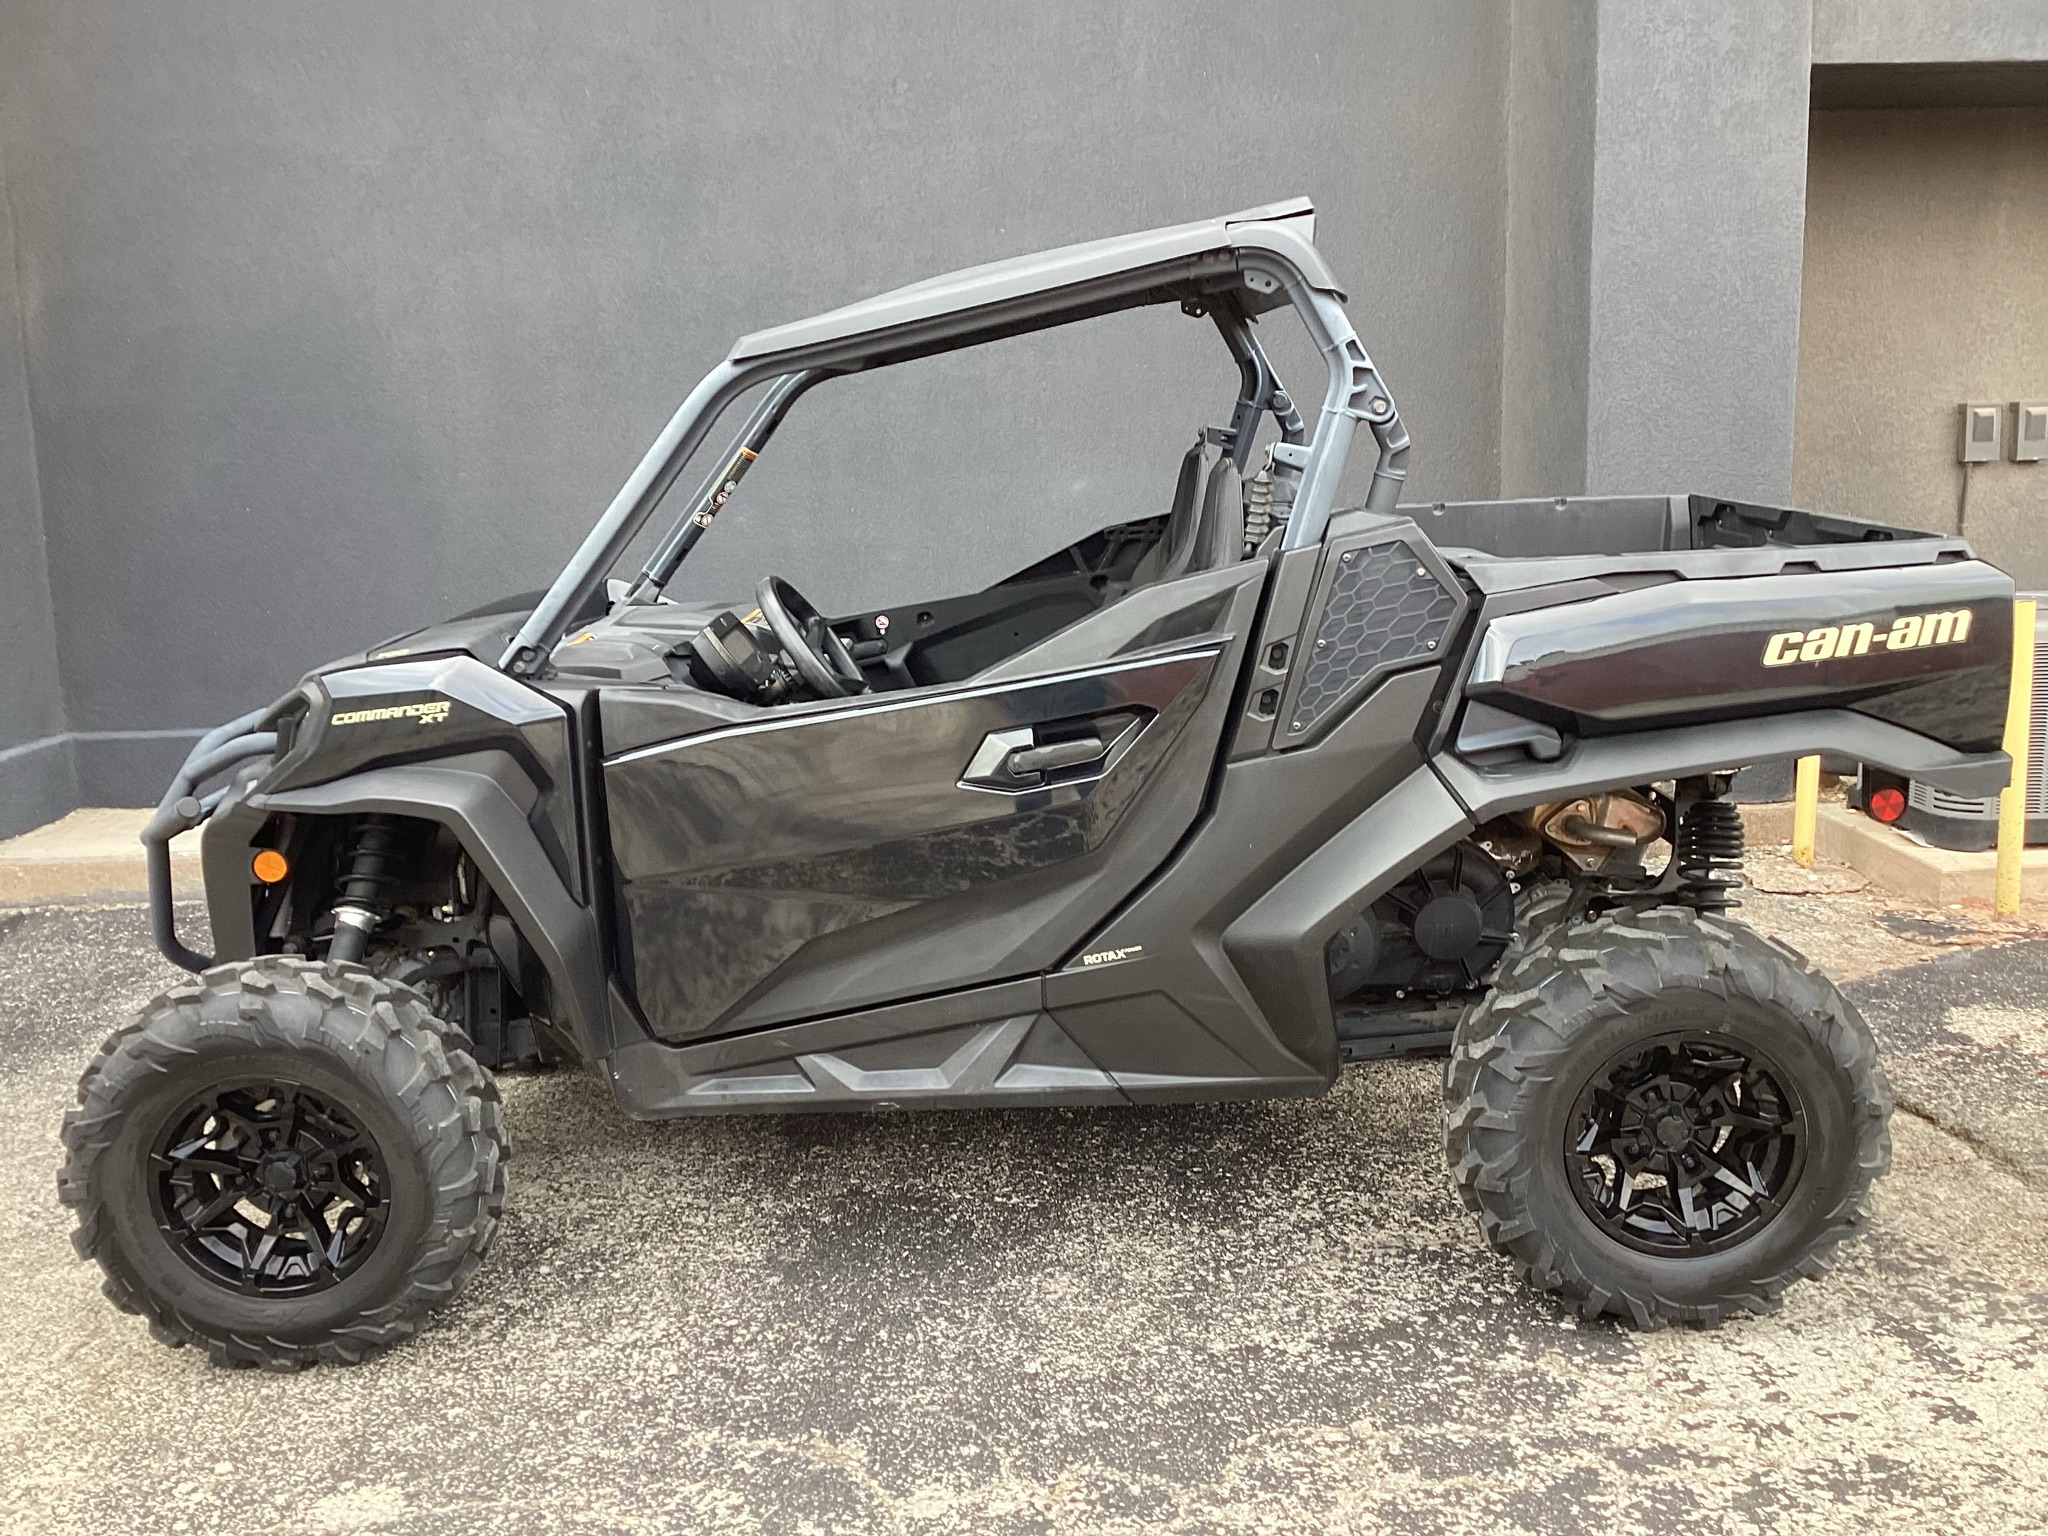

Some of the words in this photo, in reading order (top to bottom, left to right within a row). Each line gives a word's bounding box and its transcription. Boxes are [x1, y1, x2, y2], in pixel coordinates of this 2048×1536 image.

[1762, 609, 1972, 667] can-am
[331, 701, 450, 725] COMMANDER
[419, 713, 448, 724] XT
[1083, 949, 1126, 965] ROTAX
